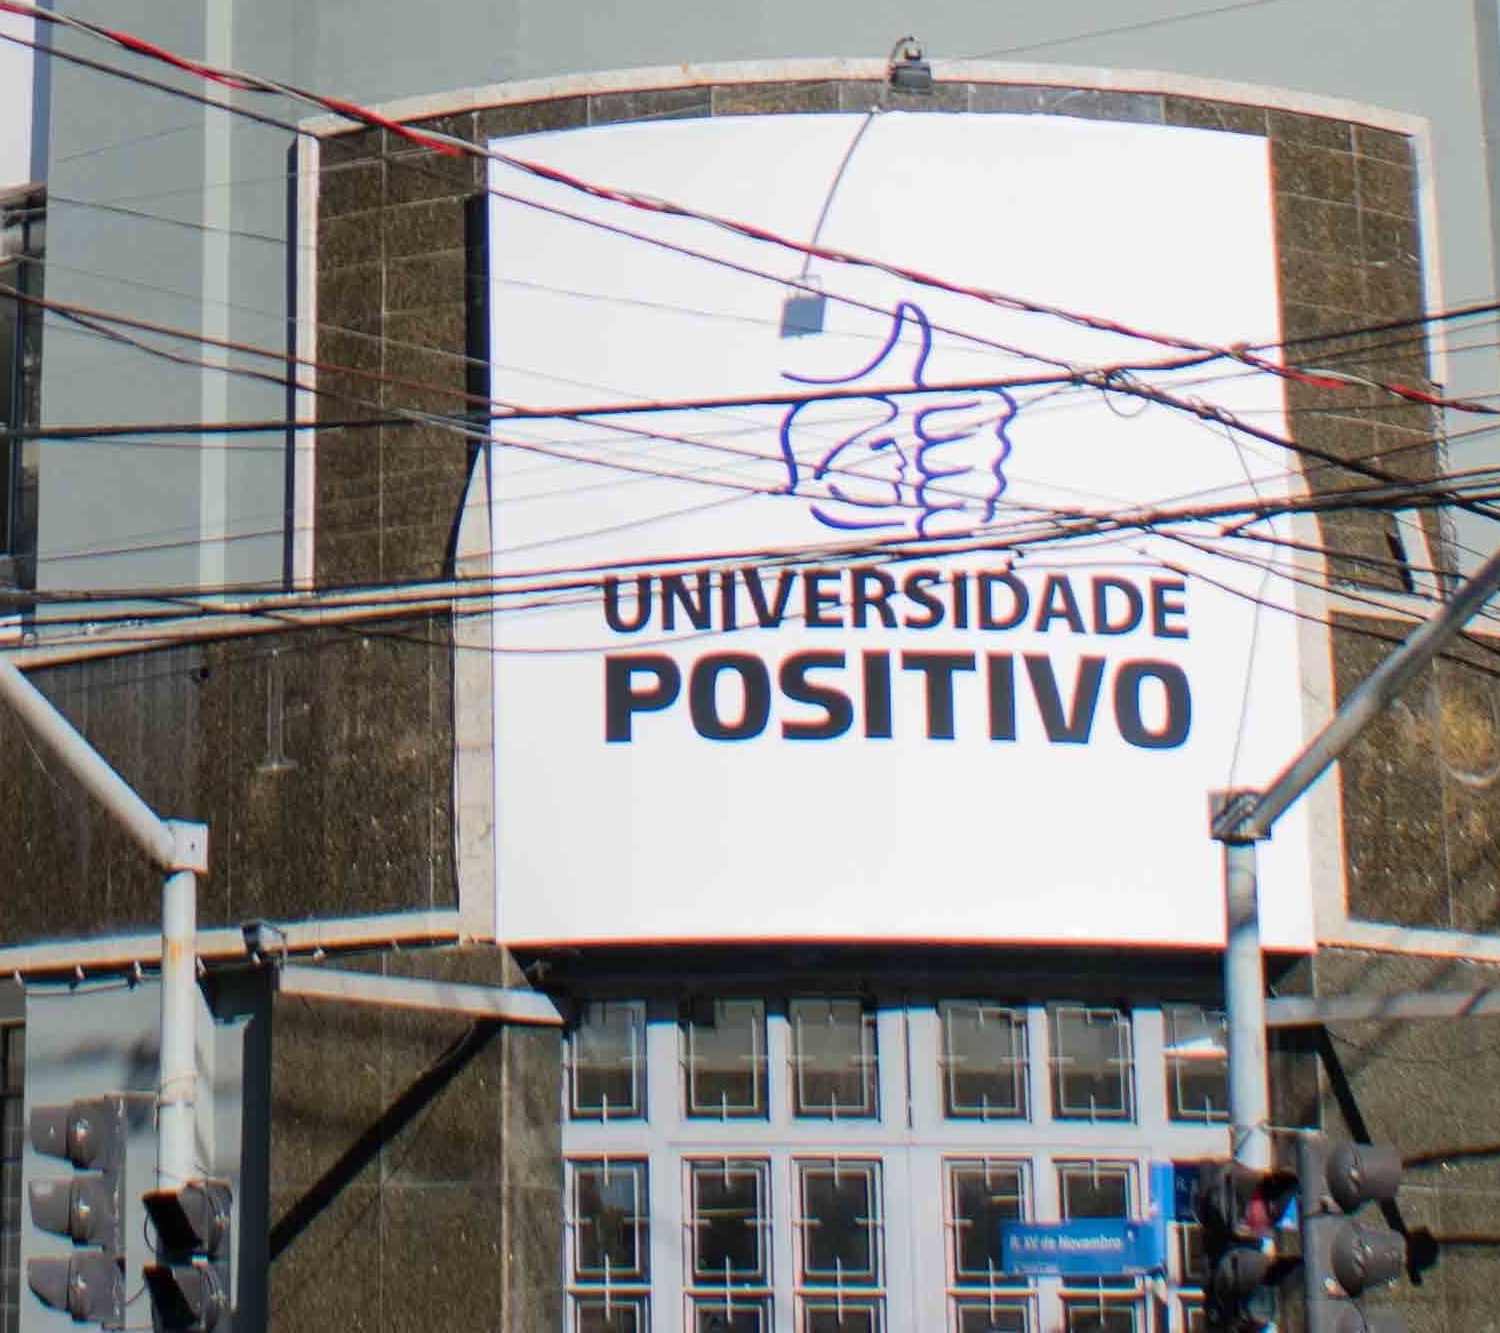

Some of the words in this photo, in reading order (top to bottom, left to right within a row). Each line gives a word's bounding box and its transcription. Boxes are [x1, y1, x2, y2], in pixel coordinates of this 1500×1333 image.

[603, 565, 1190, 639] UNIVERSIDADE
[603, 649, 1192, 749] POSITIVO
[1059, 1234, 1123, 1252] Novembro
